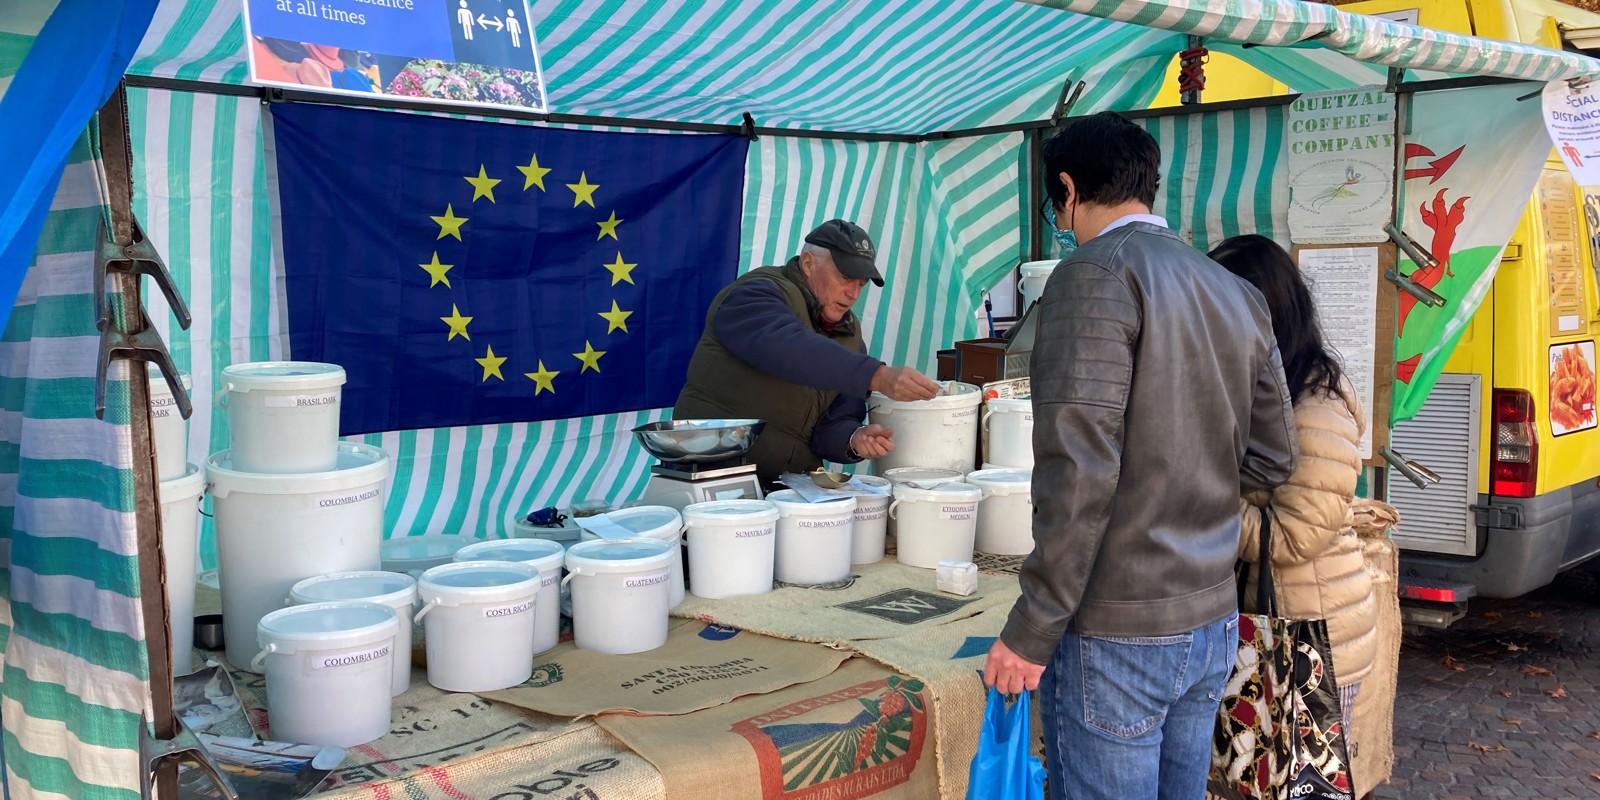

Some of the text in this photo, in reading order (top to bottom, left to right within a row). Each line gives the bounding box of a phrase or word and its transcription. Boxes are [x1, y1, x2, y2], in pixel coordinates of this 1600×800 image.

[276, 0, 366, 25] at all times
[1292, 91, 1388, 112] QUETZAL
[1292, 114, 1371, 133] COFFEE
[1292, 133, 1394, 155] COMPANY
[297, 396, 336, 406] BRASIL DARK
[320, 488, 379, 507] COLOMBIA MEDIUM
[736, 529, 763, 538] SUMATRA
[814, 520, 835, 528] BROWN
[486, 608, 511, 617] COSTA
[512, 603, 527, 614] RICA
[325, 653, 371, 667] COLOMBIA
[621, 667, 677, 689] SANTA
